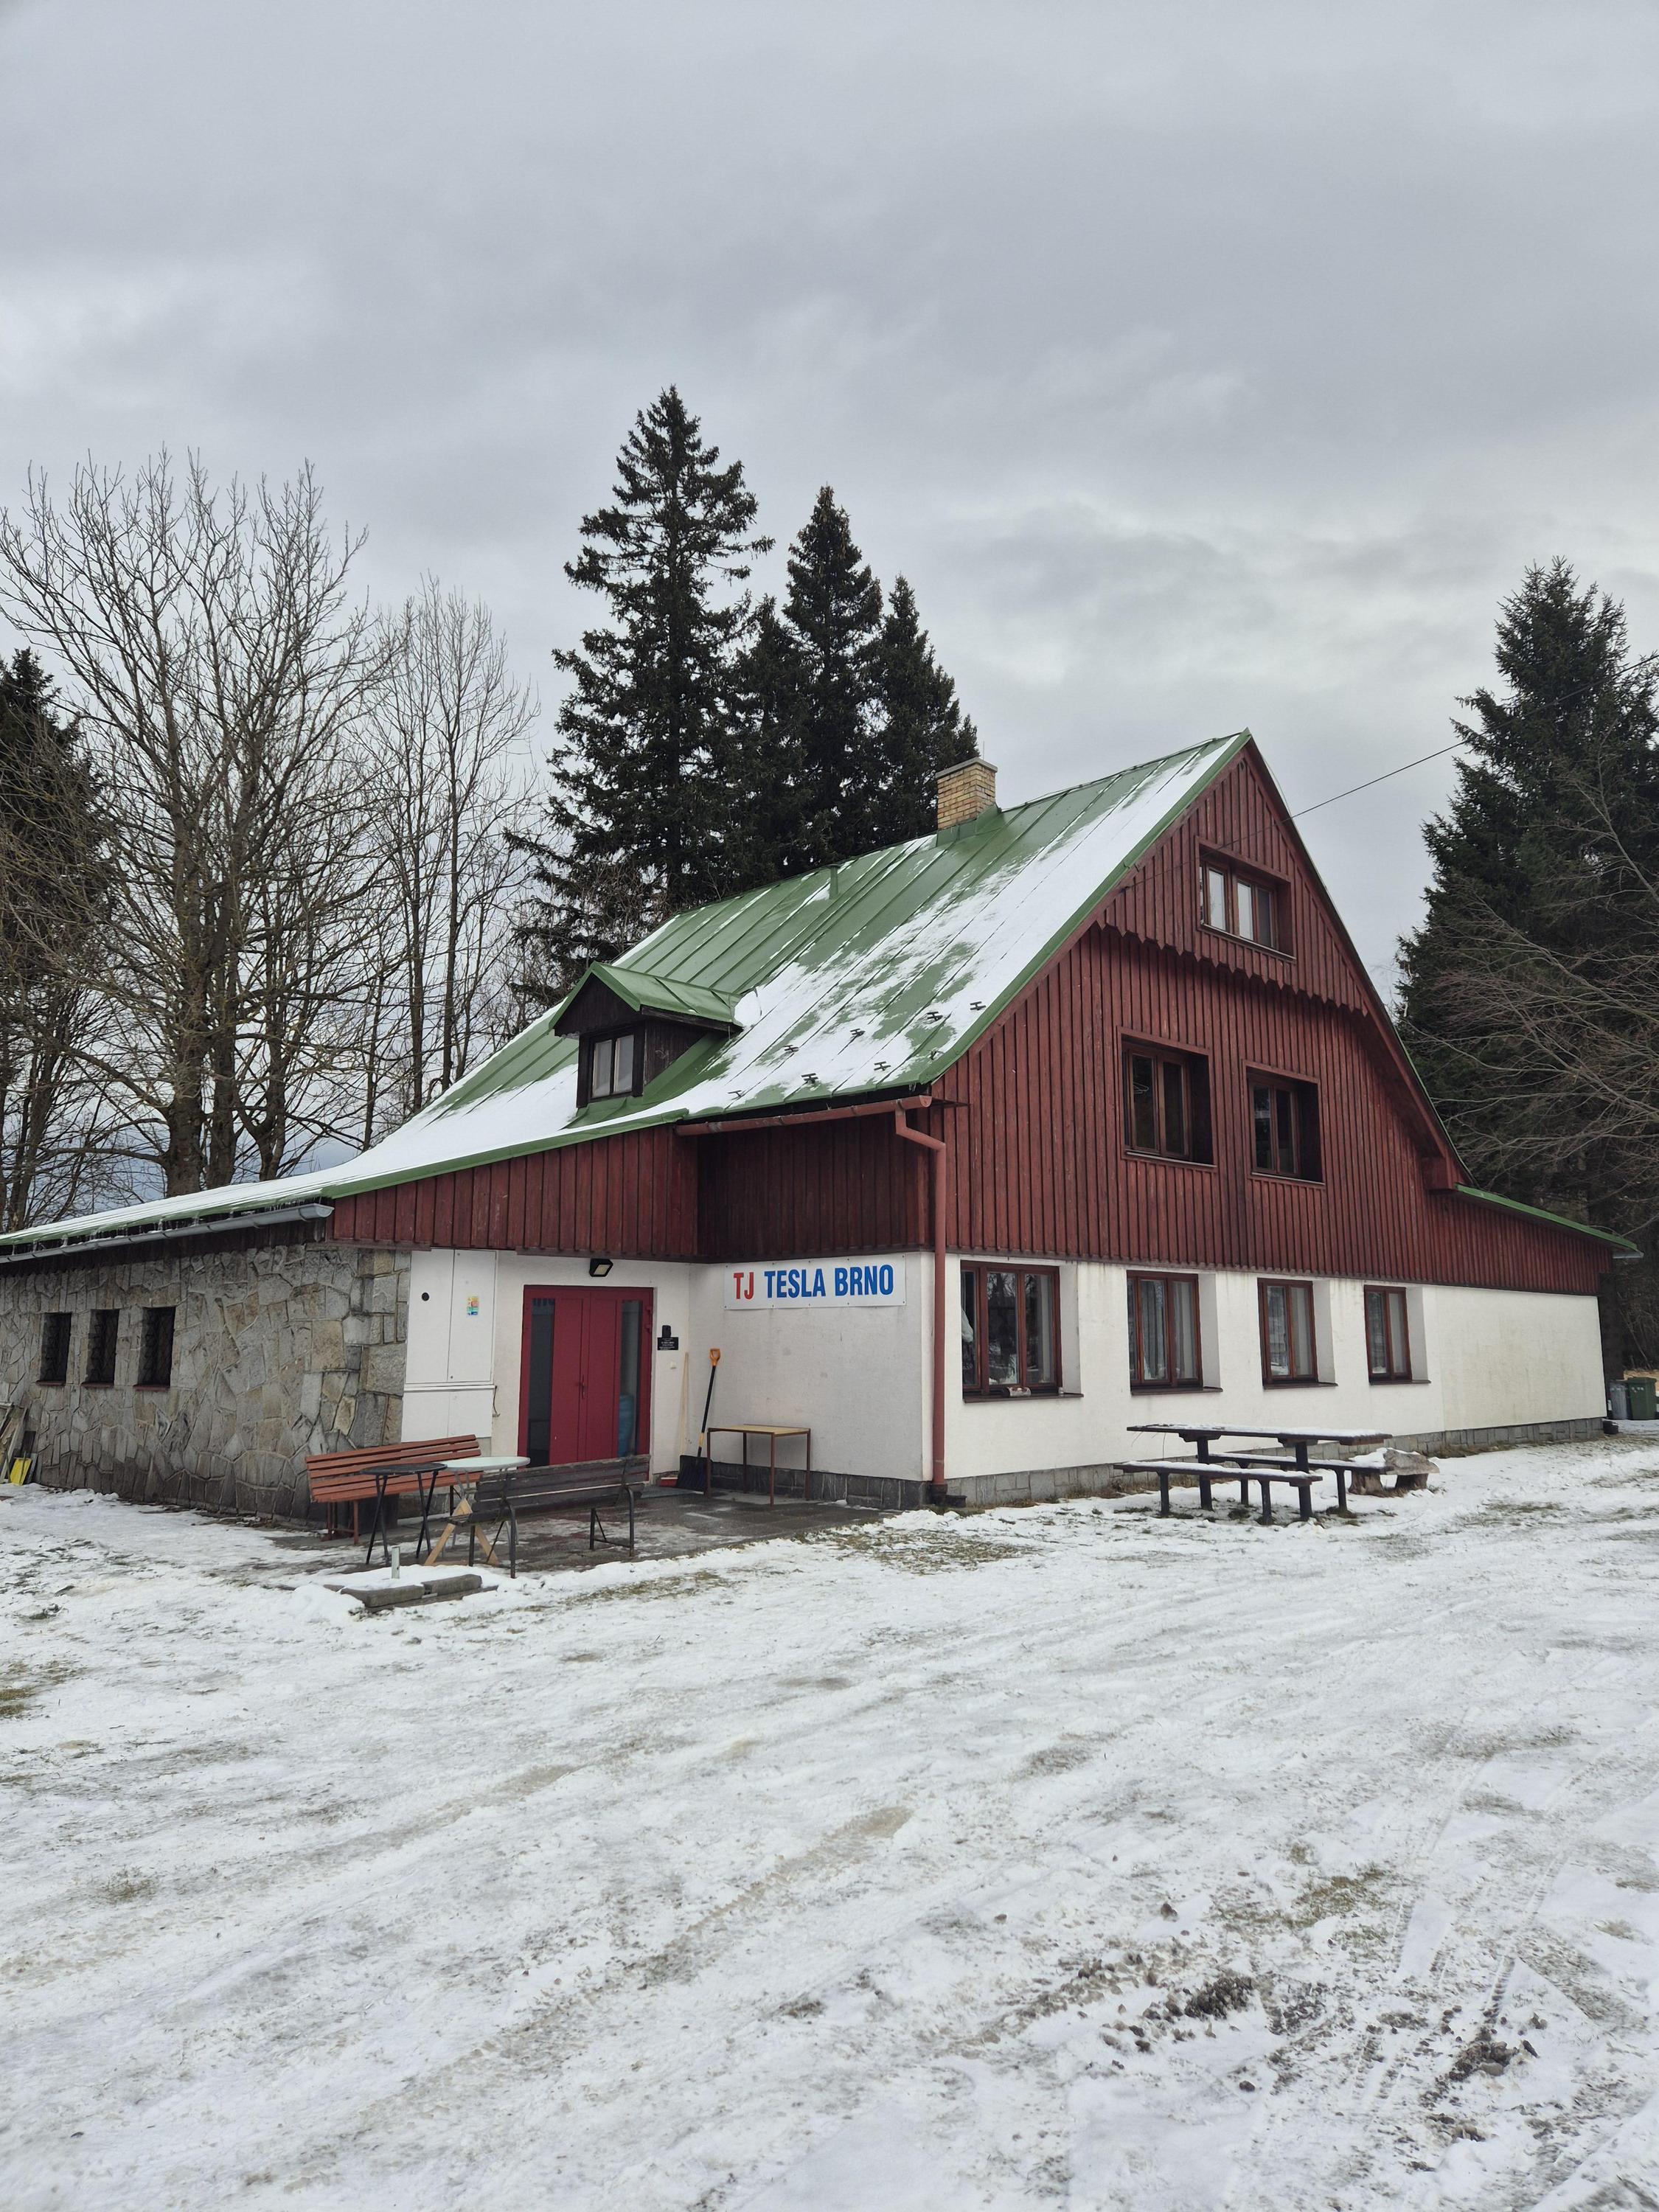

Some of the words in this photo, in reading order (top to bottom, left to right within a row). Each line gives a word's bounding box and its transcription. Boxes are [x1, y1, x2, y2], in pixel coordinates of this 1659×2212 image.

[734, 1272, 754, 1300] TJ
[764, 1268, 826, 1298] TESLA
[835, 1264, 894, 1296] BRNO
